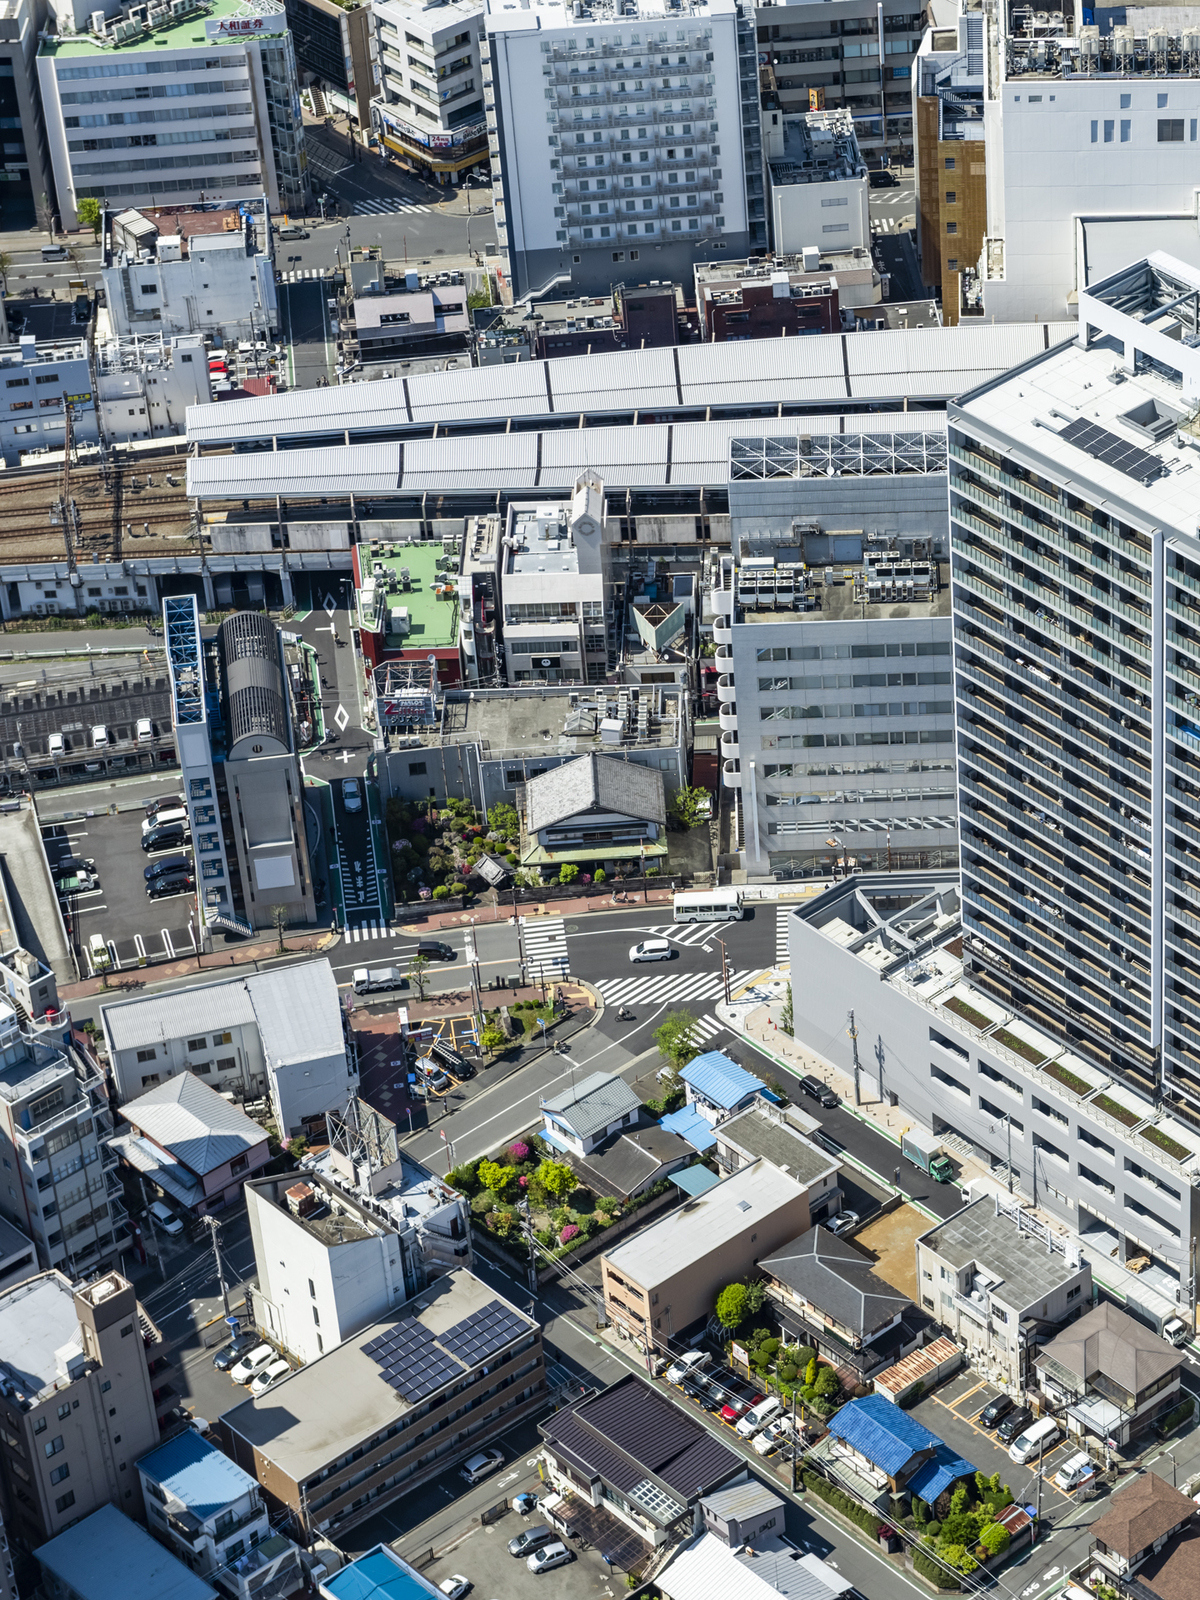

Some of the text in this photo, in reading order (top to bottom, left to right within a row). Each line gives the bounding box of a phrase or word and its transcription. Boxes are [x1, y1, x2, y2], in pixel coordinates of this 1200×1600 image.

[219, 19, 263, 31] 大和証券
[391, 715, 420, 723] ジリオン
